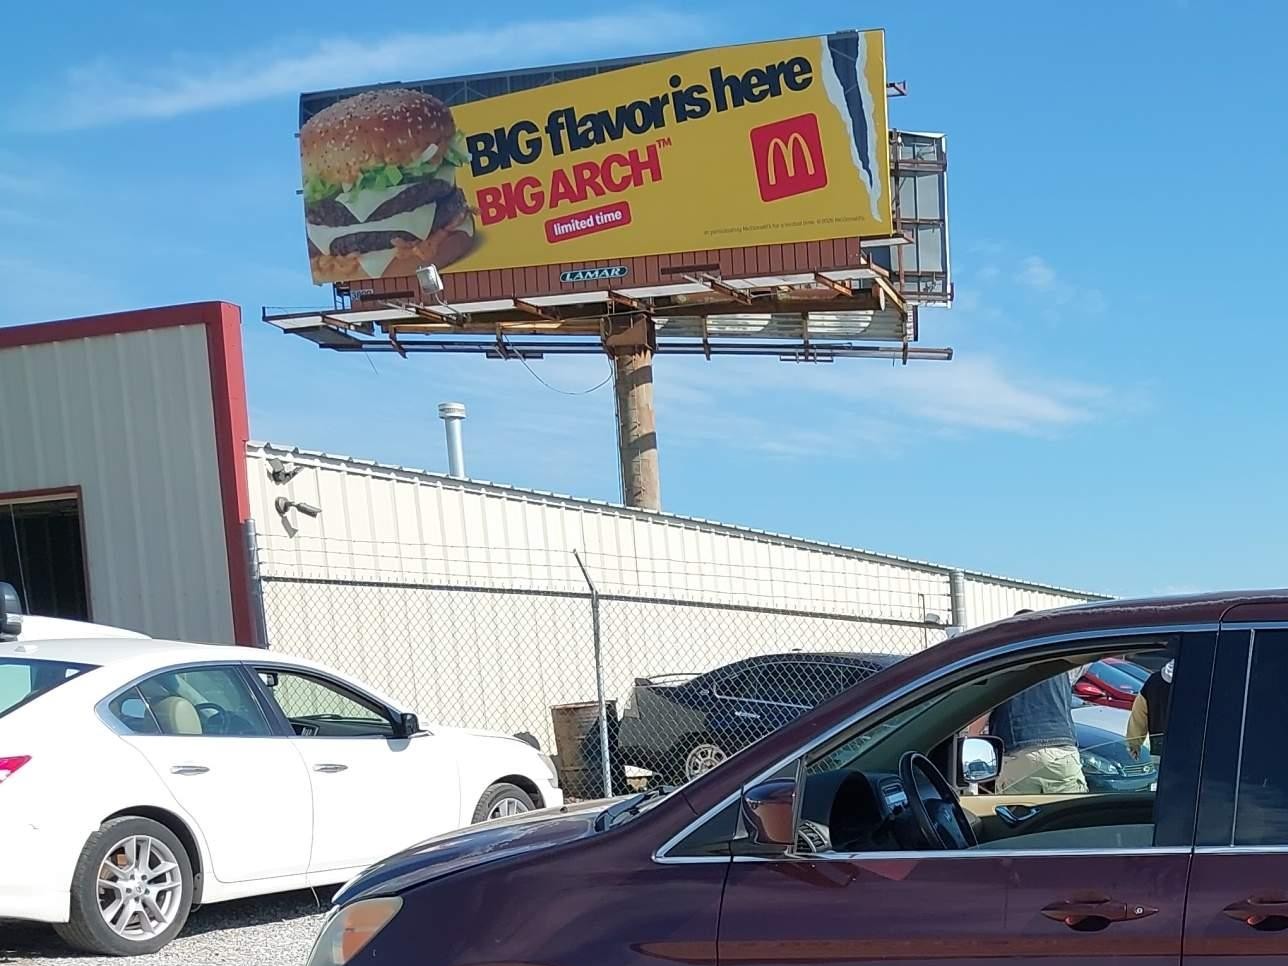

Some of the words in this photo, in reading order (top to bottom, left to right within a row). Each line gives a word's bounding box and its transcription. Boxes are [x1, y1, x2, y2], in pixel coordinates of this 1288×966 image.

[466, 120, 542, 177] BIG
[545, 93, 670, 157] flavor
[669, 74, 712, 124] is
[709, 56, 813, 112] here
[476, 175, 545, 226] BIG
[553, 216, 594, 236] limited
[596, 210, 622, 226] time
[565, 267, 622, 282] LAMAR
